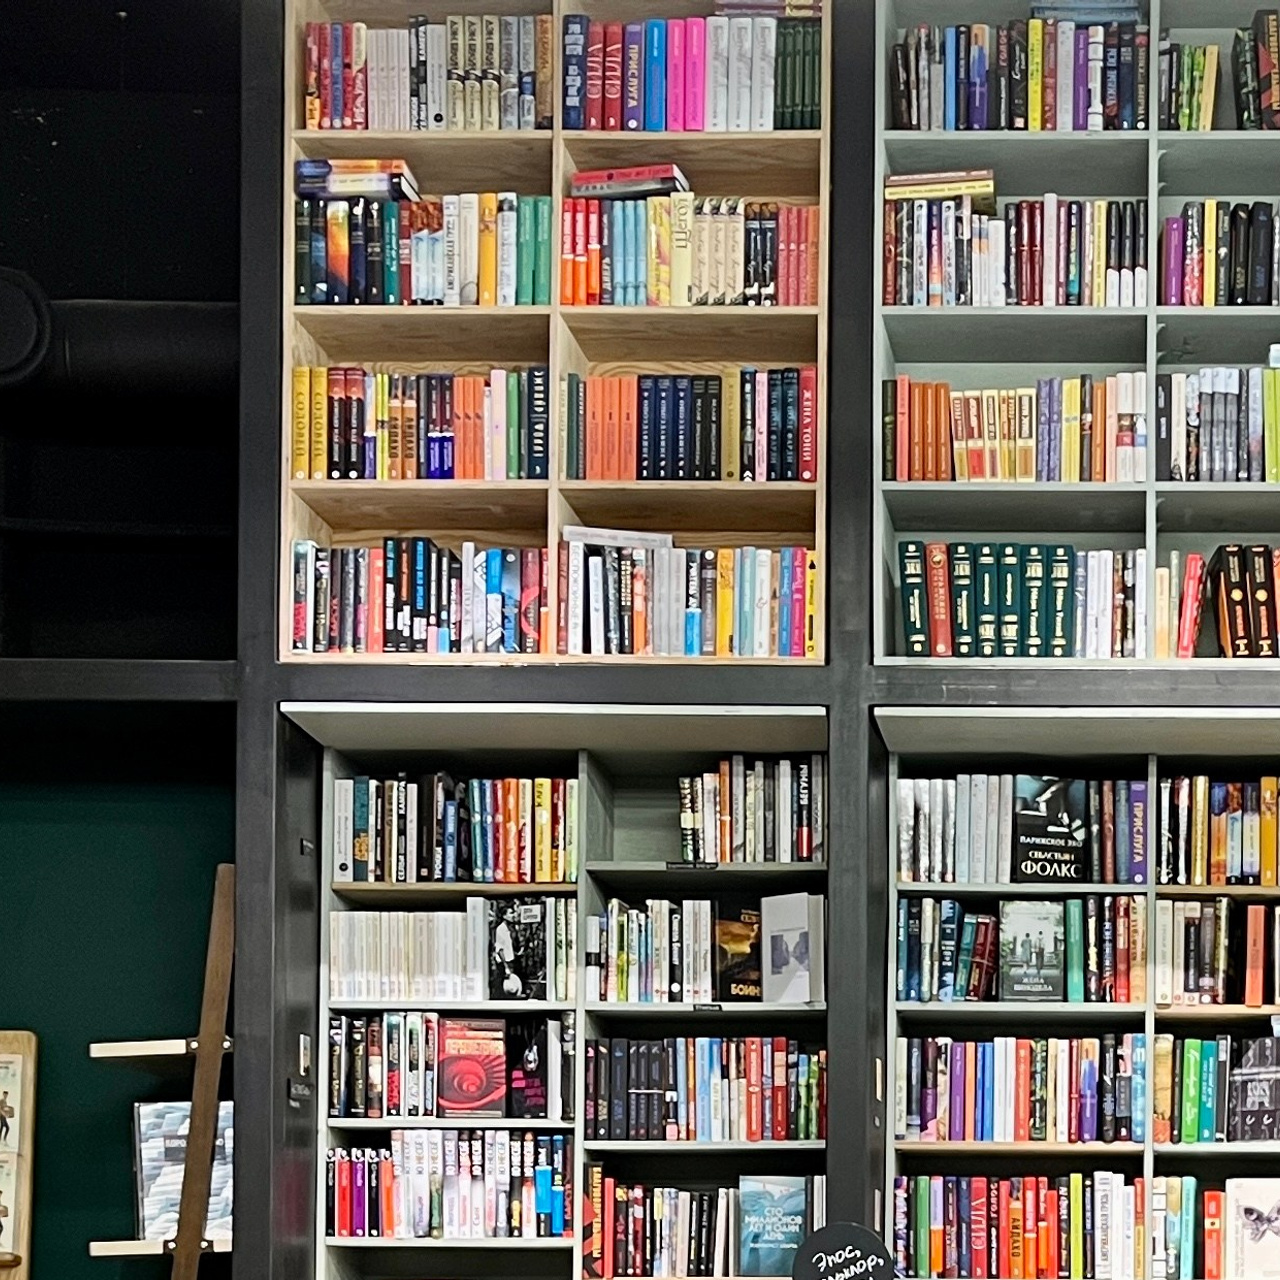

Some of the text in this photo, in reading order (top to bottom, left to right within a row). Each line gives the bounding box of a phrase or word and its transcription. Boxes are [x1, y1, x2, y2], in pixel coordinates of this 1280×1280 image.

[586, 43, 602, 99] СИЛА
[604, 43, 620, 99] СИЛА
[999, 29, 1007, 66] ГОЛОС
[628, 45, 639, 108] ПРИСЛУГА
[673, 199, 692, 249] Щегол
[296, 392, 305, 457] СОЛОВЕЙ
[313, 392, 324, 457] СОЛОВЕЙ
[802, 389, 812, 460] ЖЕНА ТОНИ
[398, 781, 407, 814] КАМЕРА
[799, 764, 809, 804] БЕГУНЫ
[1133, 802, 1144, 863] ПРИСЛУГА
[1020, 860, 1084, 878] ФОЛКС
[763, 1206, 783, 1215] СТО
[971, 1197, 986, 1250] СИЛА
[990, 1183, 998, 1218] ГОЛОС
[748, 1223, 764, 1232] ЛЕТ
[811, 1244, 862, 1273] Эпос,
